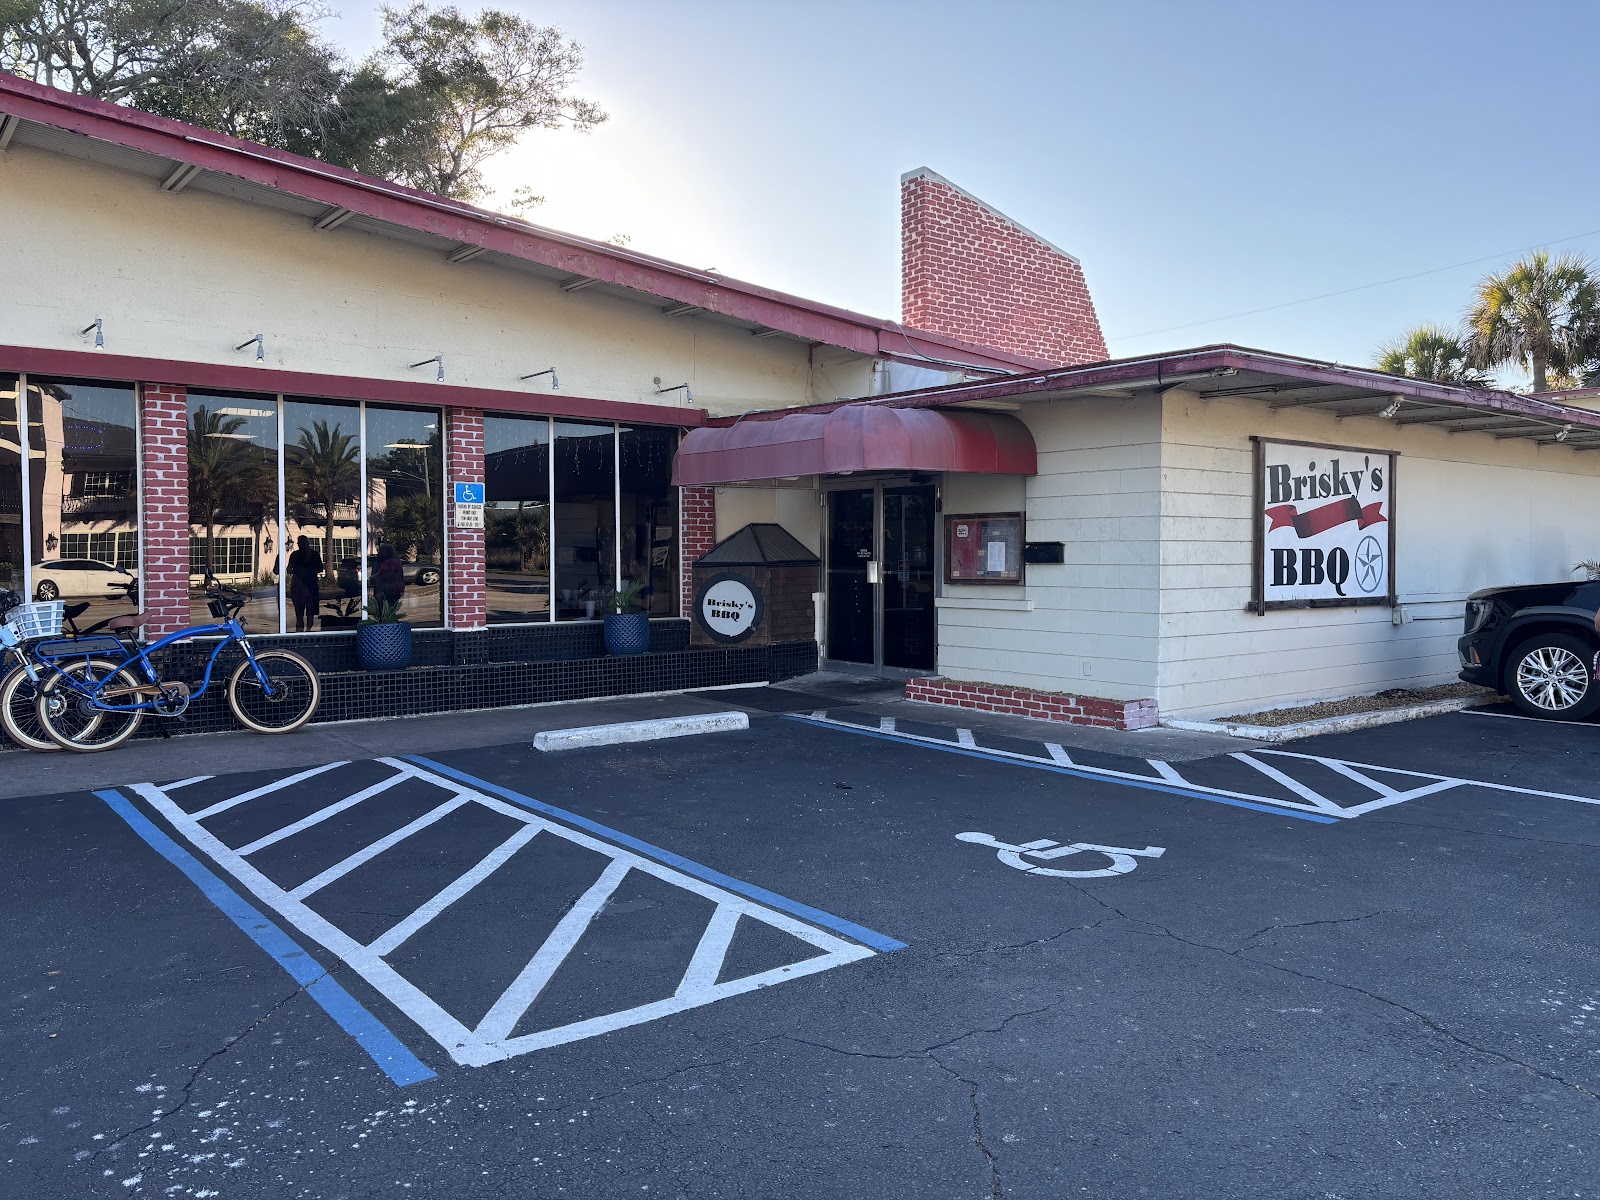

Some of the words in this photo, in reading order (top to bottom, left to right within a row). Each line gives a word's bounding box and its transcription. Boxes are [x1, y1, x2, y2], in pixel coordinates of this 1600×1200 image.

[1267, 456, 1383, 505] Brisky's
[1270, 547, 1349, 596] BBQ
[707, 598, 753, 610] Brisky's
[711, 609, 740, 622] BBQ
